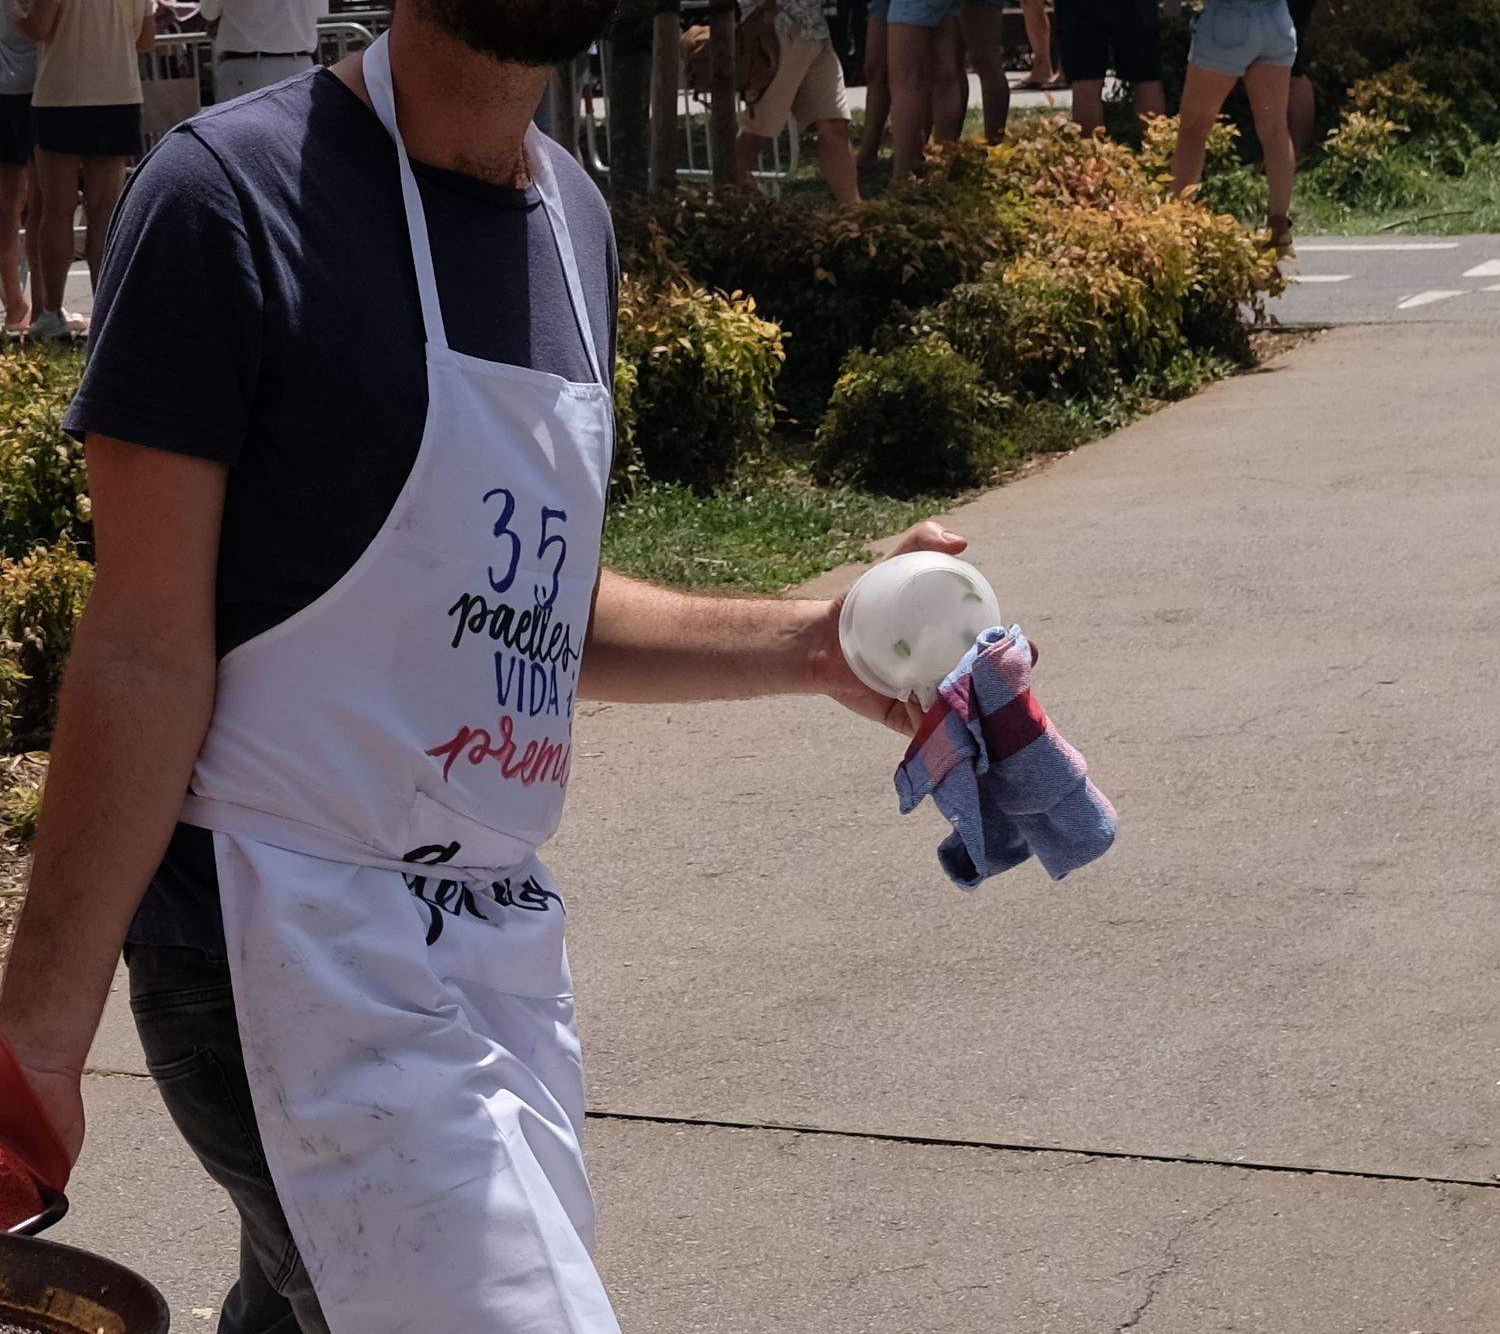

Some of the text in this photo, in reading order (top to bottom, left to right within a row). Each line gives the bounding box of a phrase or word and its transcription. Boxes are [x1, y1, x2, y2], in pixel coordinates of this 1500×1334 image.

[482, 487, 568, 611] 35
[448, 592, 582, 672] paelles
[494, 650, 560, 716] VIDA
